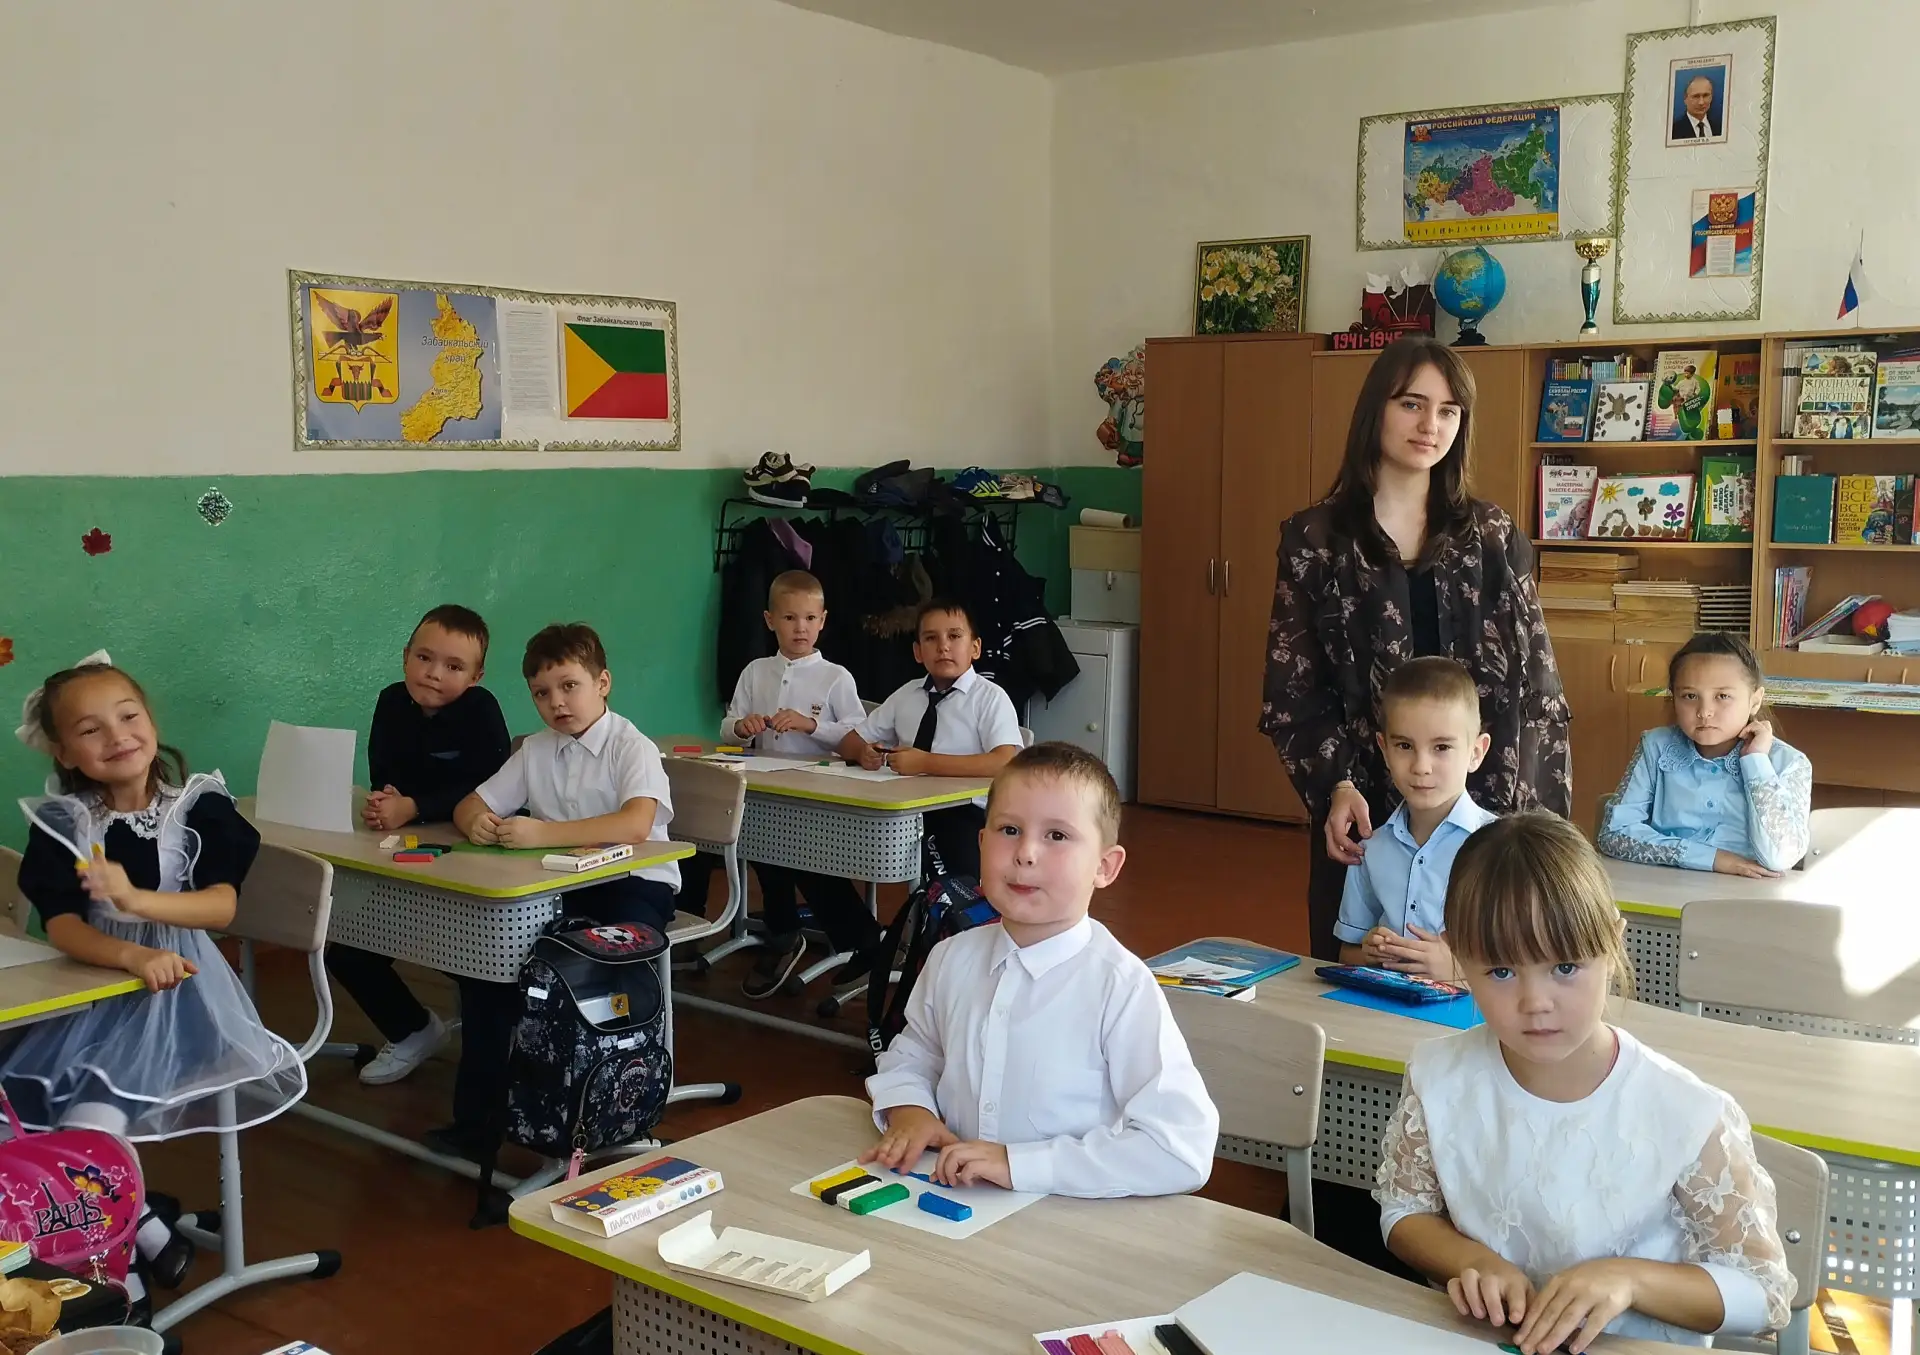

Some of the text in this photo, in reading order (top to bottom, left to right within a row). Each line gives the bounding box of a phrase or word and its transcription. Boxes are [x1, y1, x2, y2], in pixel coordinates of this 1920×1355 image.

[1432, 113, 1536, 129] РОССИЙСКАЯ ФЕДЕРАЦИЯ
[577, 315, 592, 323] Флаг
[592, 316, 639, 326] Забайкальского
[421, 335, 489, 349] Забайкальский
[445, 353, 466, 363] край
[1814, 378, 1858, 389] ПОЛНАЯ
[1804, 392, 1866, 402] ЖИВОТНЫХ
[1841, 479, 1872, 490] ВСЕ
[1840, 491, 1870, 502] ВСЕ
[1840, 503, 1867, 514] ВСЕ
[35, 1184, 106, 1237] PARIS
[609, 1205, 652, 1232] ПЛАСТИЛИН
